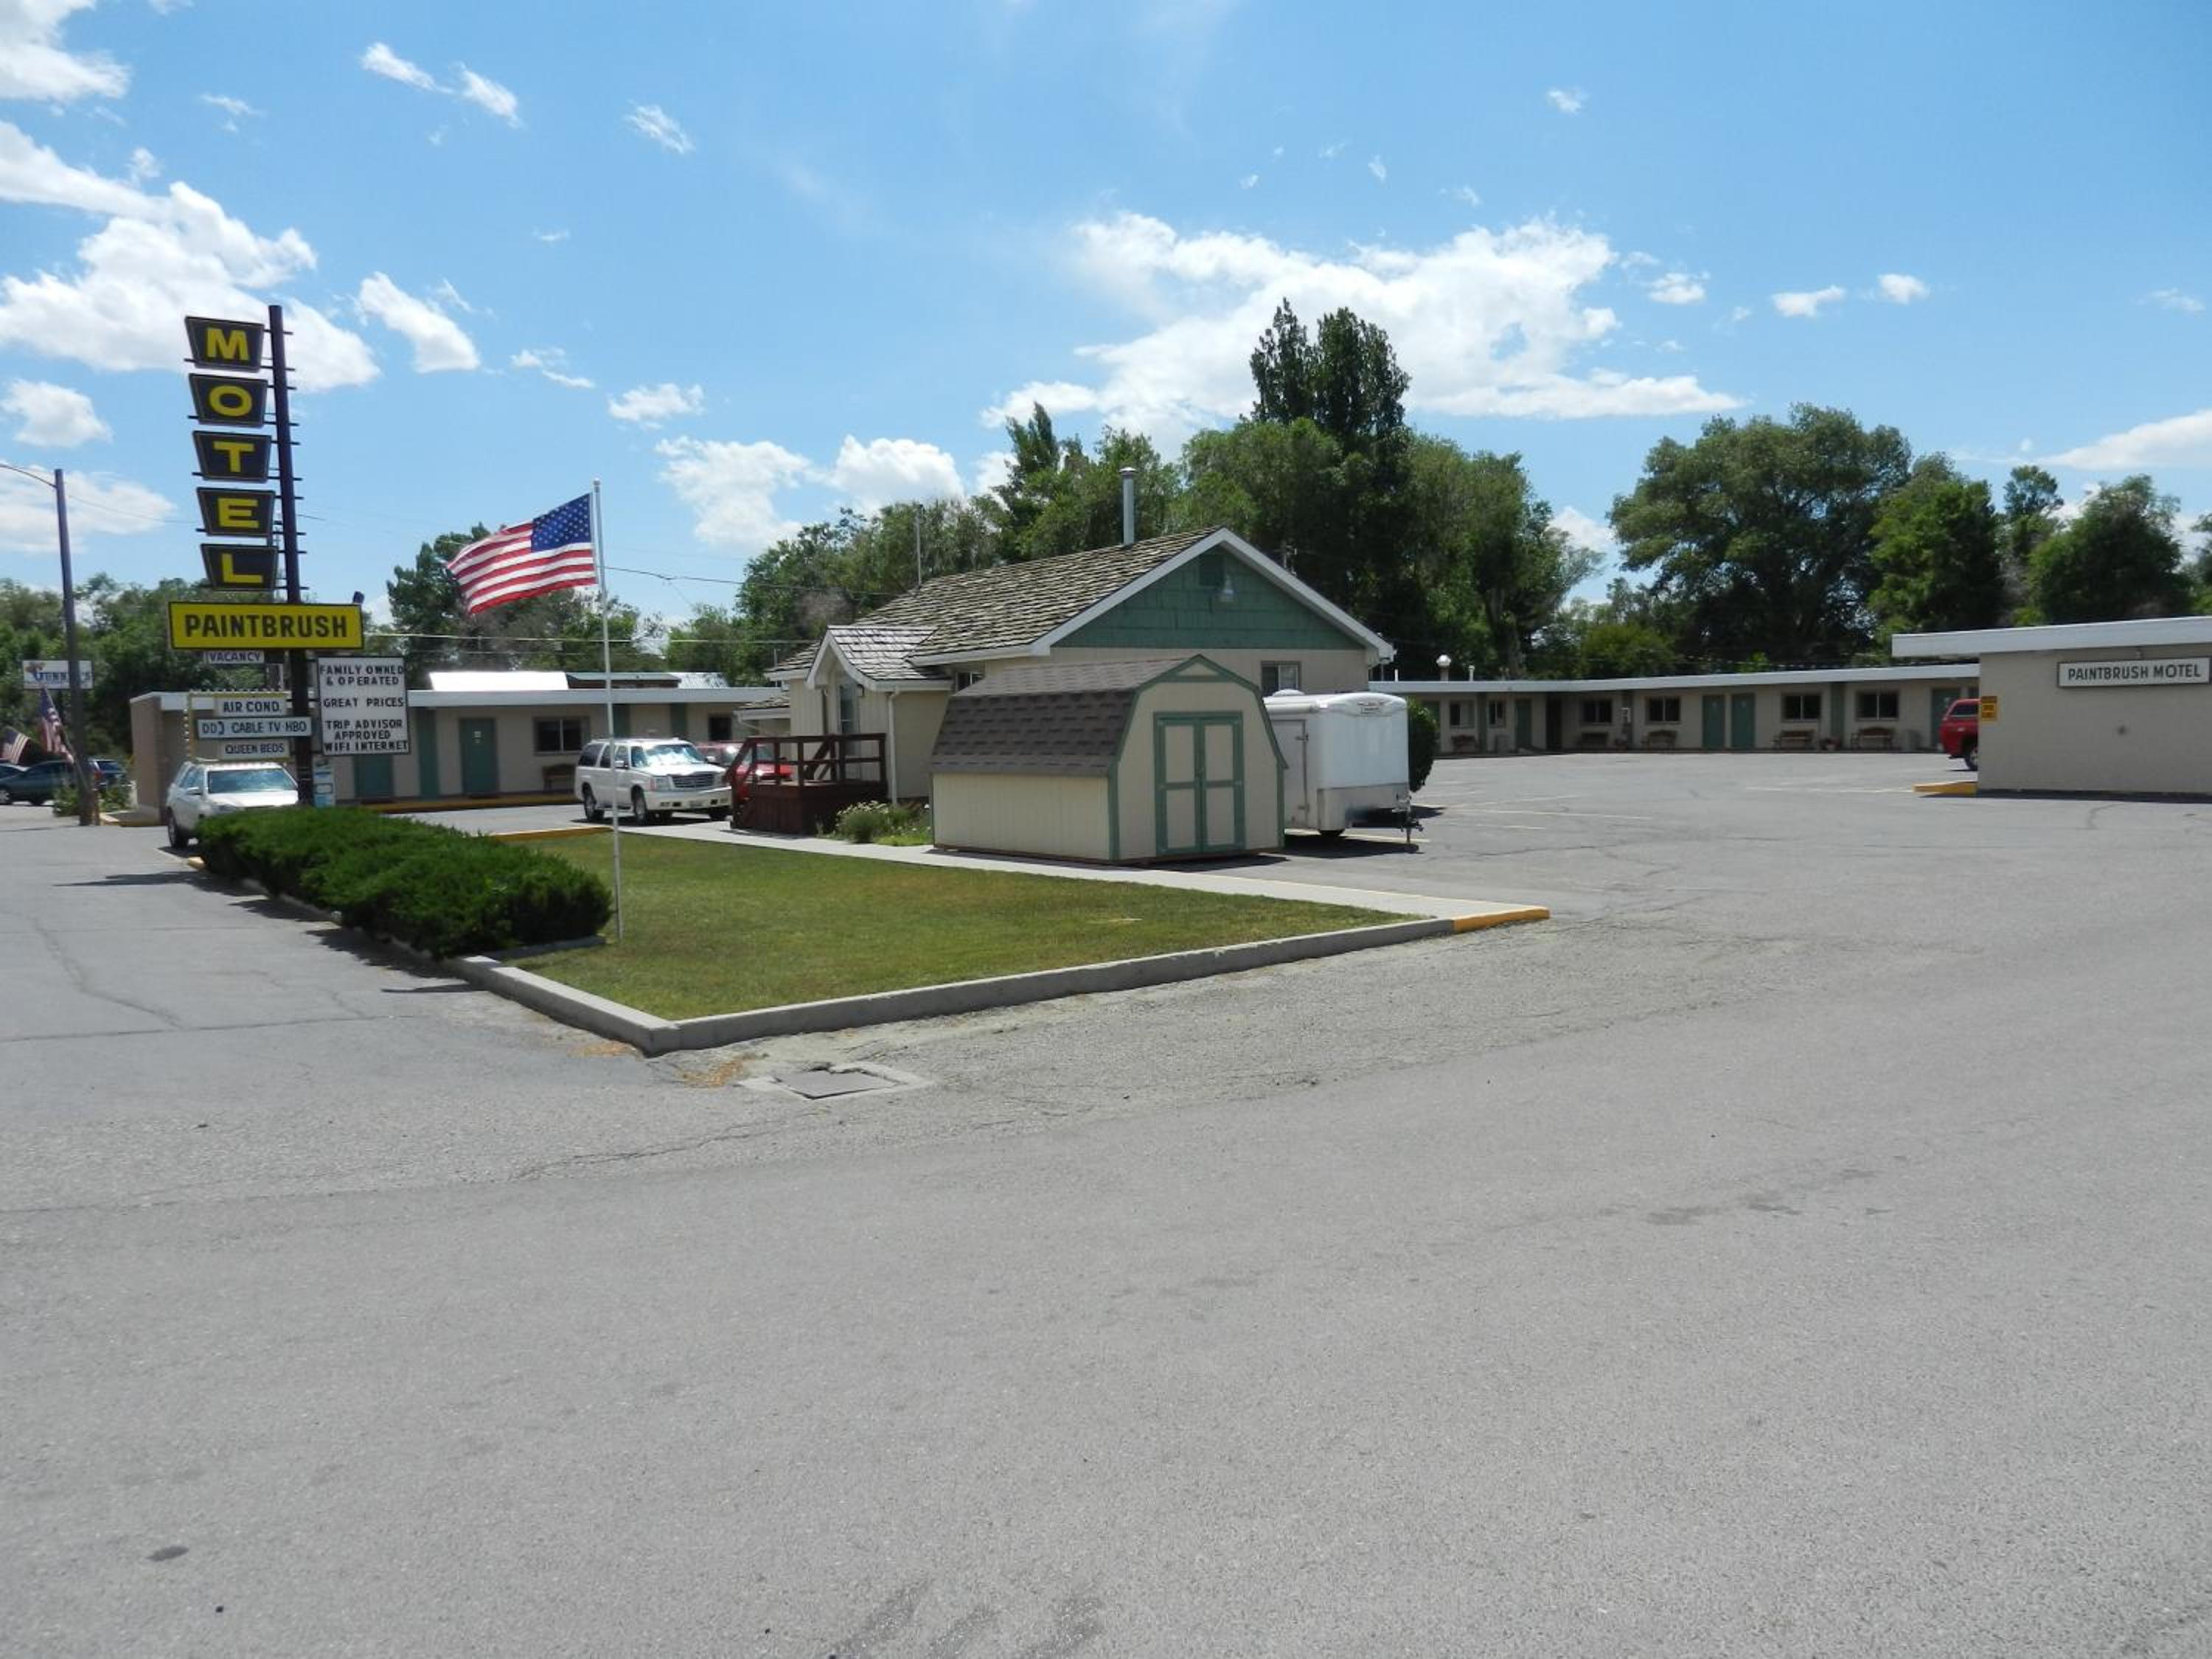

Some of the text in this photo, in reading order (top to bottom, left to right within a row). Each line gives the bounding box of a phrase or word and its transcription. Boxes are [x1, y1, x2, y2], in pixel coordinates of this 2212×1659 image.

[206, 327, 262, 584] MOTEL
[185, 614, 347, 637] PAINTBRUSH
[209, 651, 260, 662] VACANCY
[320, 665, 403, 675] FAMILY OWNED
[2068, 664, 2202, 681] PAINTBRUSH MOTEL
[327, 676, 399, 686] & OPERATED
[223, 701, 243, 712] AIR
[324, 697, 404, 707] GREAT PRICES
[232, 722, 263, 734] CABLE
[268, 721, 281, 732] TV
[285, 720, 307, 732] HBO
[326, 719, 403, 729] TRIP ADVISOR
[335, 730, 391, 740] APPROVED
[225, 742, 284, 754] QUEEN BEDS
[324, 740, 408, 751] WIFI INTERNET
